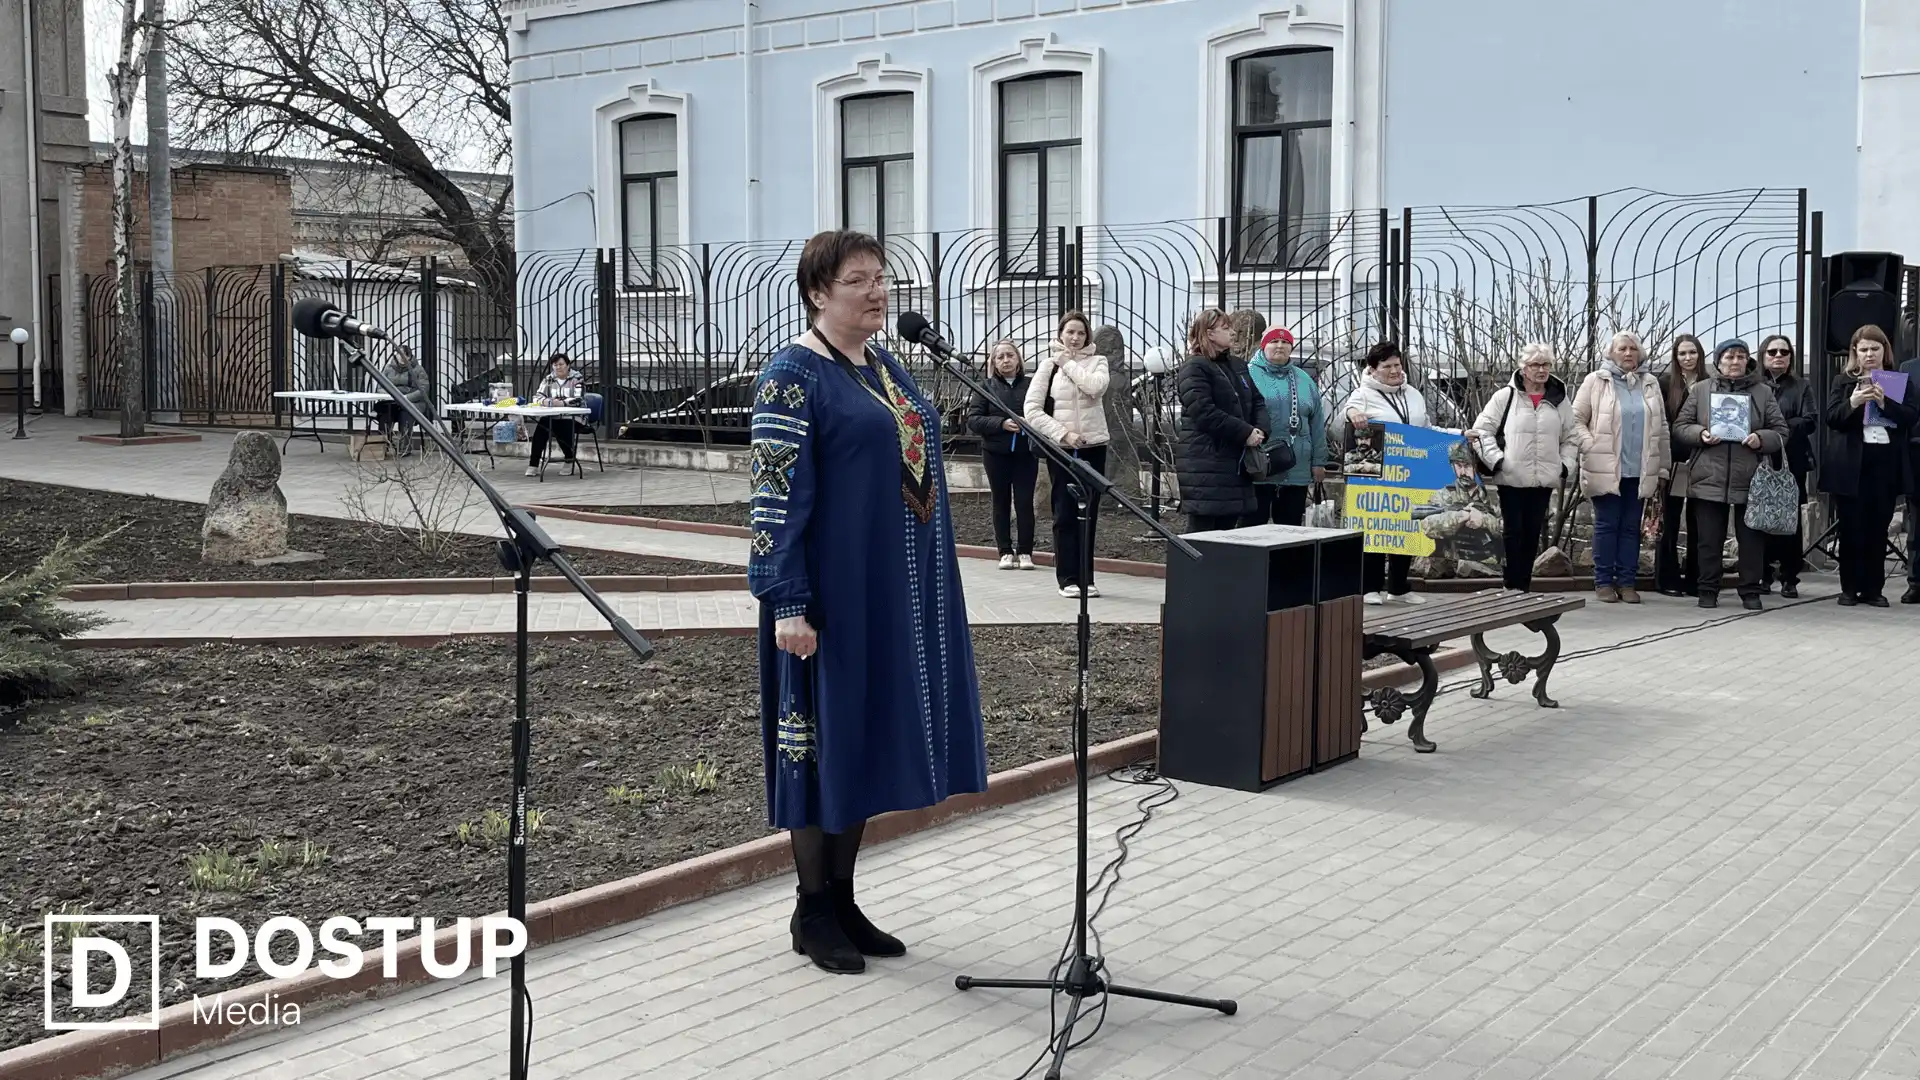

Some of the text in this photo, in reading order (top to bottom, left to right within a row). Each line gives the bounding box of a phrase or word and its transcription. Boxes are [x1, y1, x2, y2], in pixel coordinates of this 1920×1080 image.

[1357, 492, 1410, 513] «ШАС»
[1342, 516, 1421, 533] ВІРА СИЛЬНІША
[1373, 534, 1405, 548] СТРАХ
